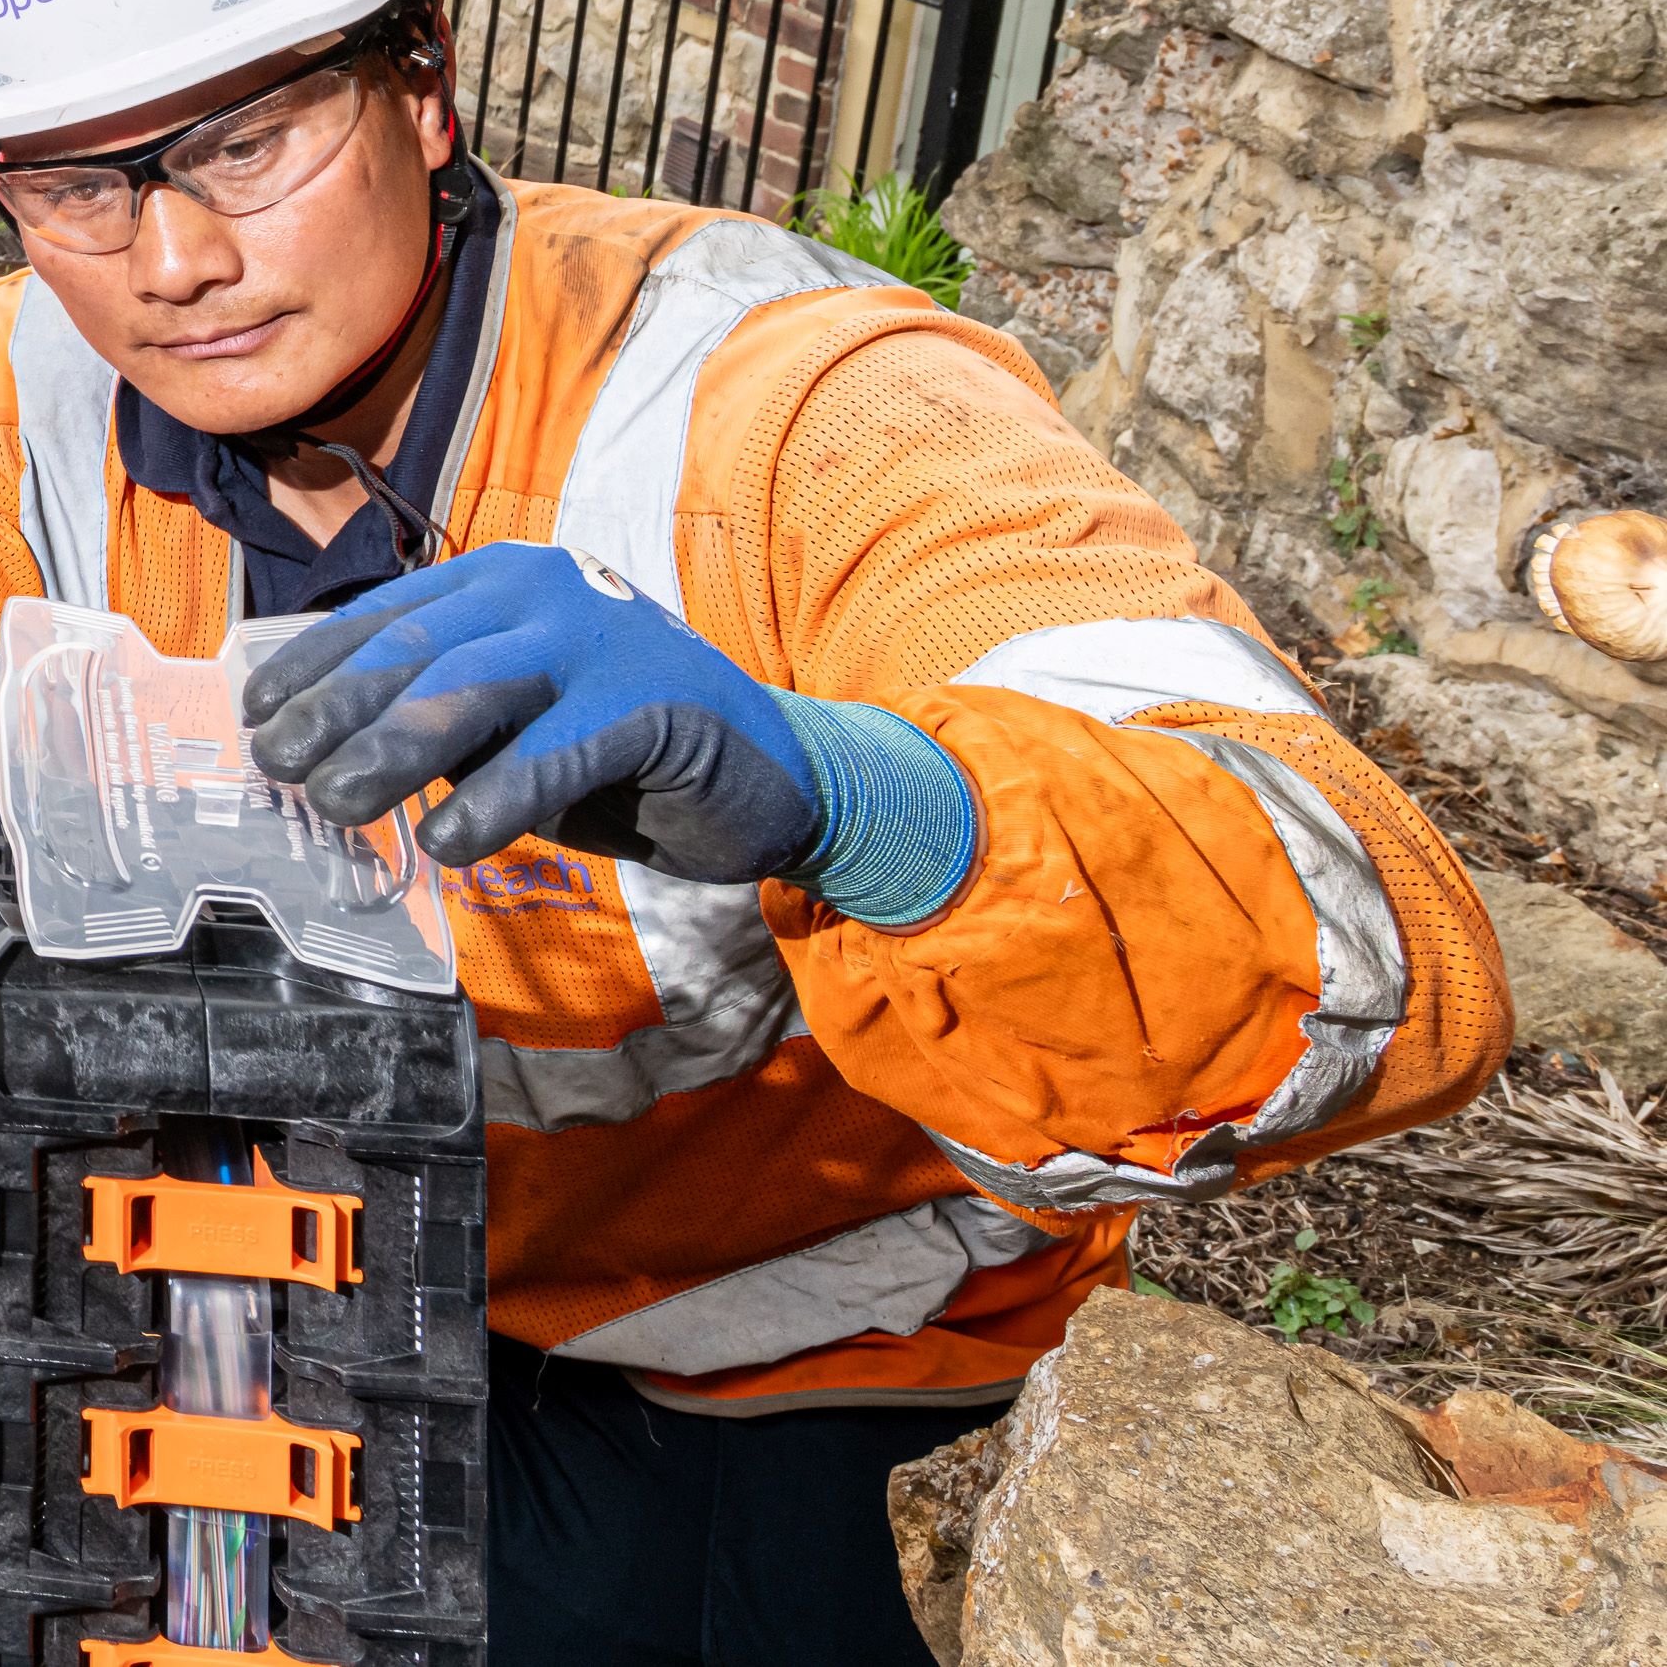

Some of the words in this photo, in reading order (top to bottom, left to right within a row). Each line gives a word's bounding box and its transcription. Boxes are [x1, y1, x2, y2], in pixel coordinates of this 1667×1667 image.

[145, 722, 180, 803] WARNING
[188, 1221, 260, 1246] PRESS
[186, 1456, 258, 1481] PRESS
